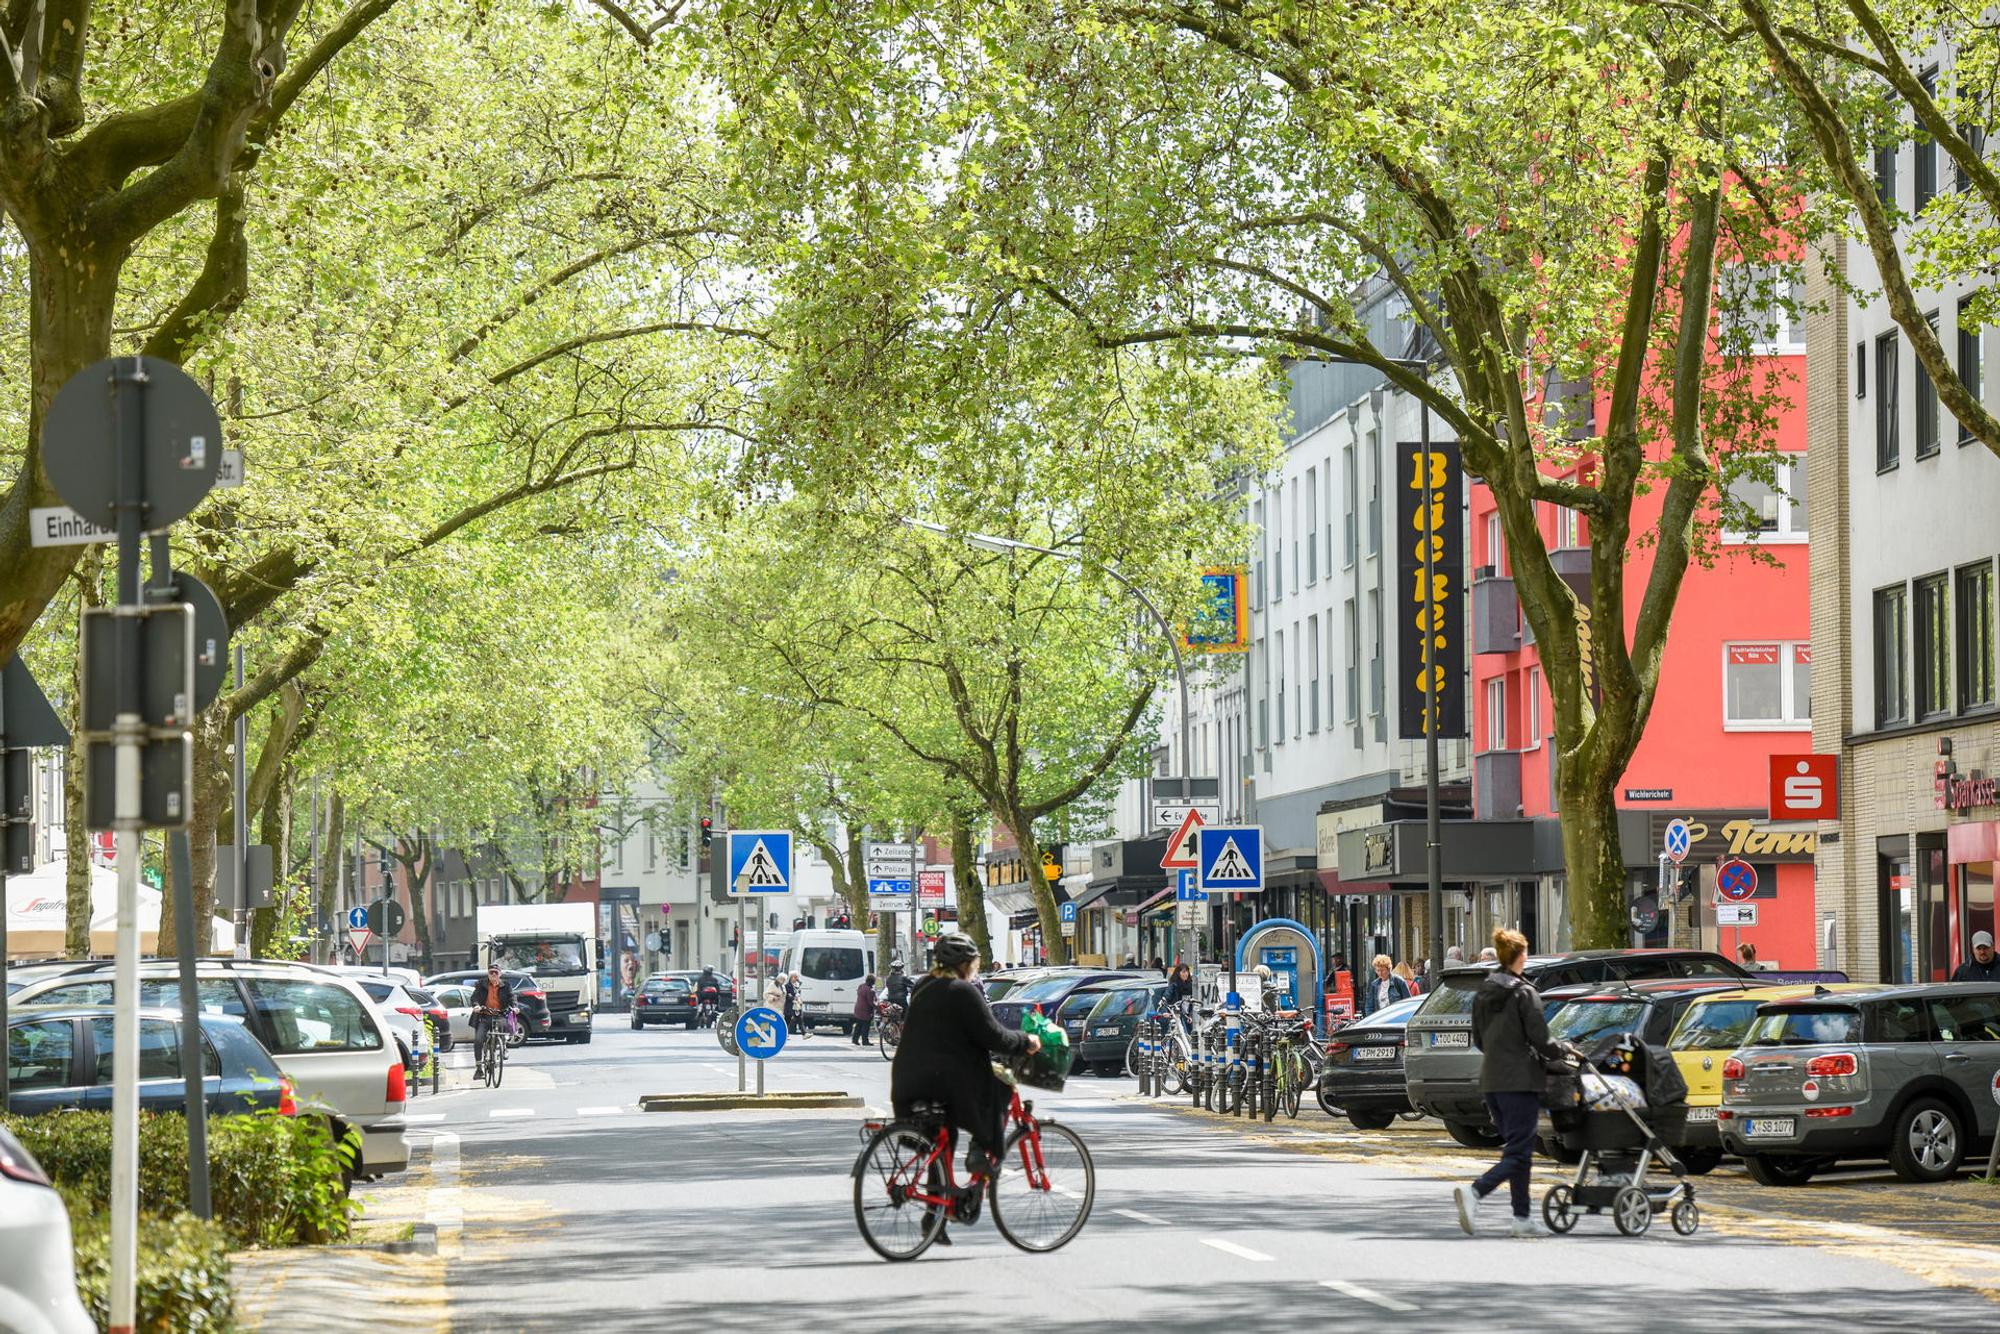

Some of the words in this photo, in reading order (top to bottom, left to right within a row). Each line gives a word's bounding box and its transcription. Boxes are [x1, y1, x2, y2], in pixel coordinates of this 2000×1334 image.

[1410, 452, 1449, 734] Bäckerei
[879, 899, 903, 907] Zentrum
[1376, 1047, 1394, 1058] 2919
[1774, 1121, 1793, 1132] 1077
